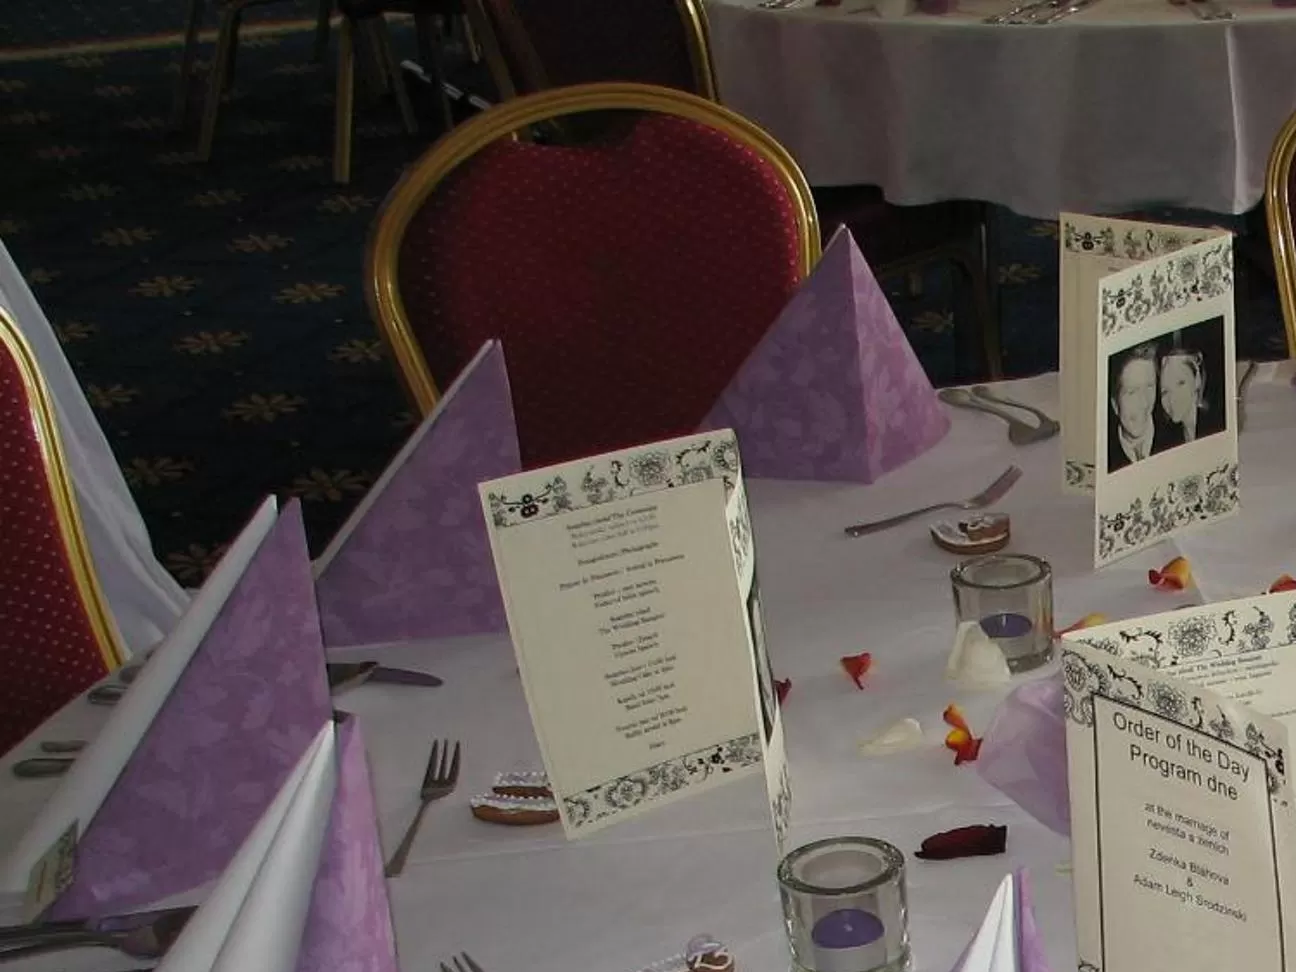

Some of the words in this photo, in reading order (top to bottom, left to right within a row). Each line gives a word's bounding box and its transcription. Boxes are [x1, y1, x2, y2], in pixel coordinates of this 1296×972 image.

[1113, 711, 1161, 744] Order
[1166, 733, 1182, 753] of
[1186, 739, 1213, 763] the
[1217, 750, 1250, 783] Day
[1130, 744, 1202, 787] Program
[1156, 805, 1173, 819] the
[1219, 830, 1230, 841] of
[1133, 874, 1163, 892] Adam
